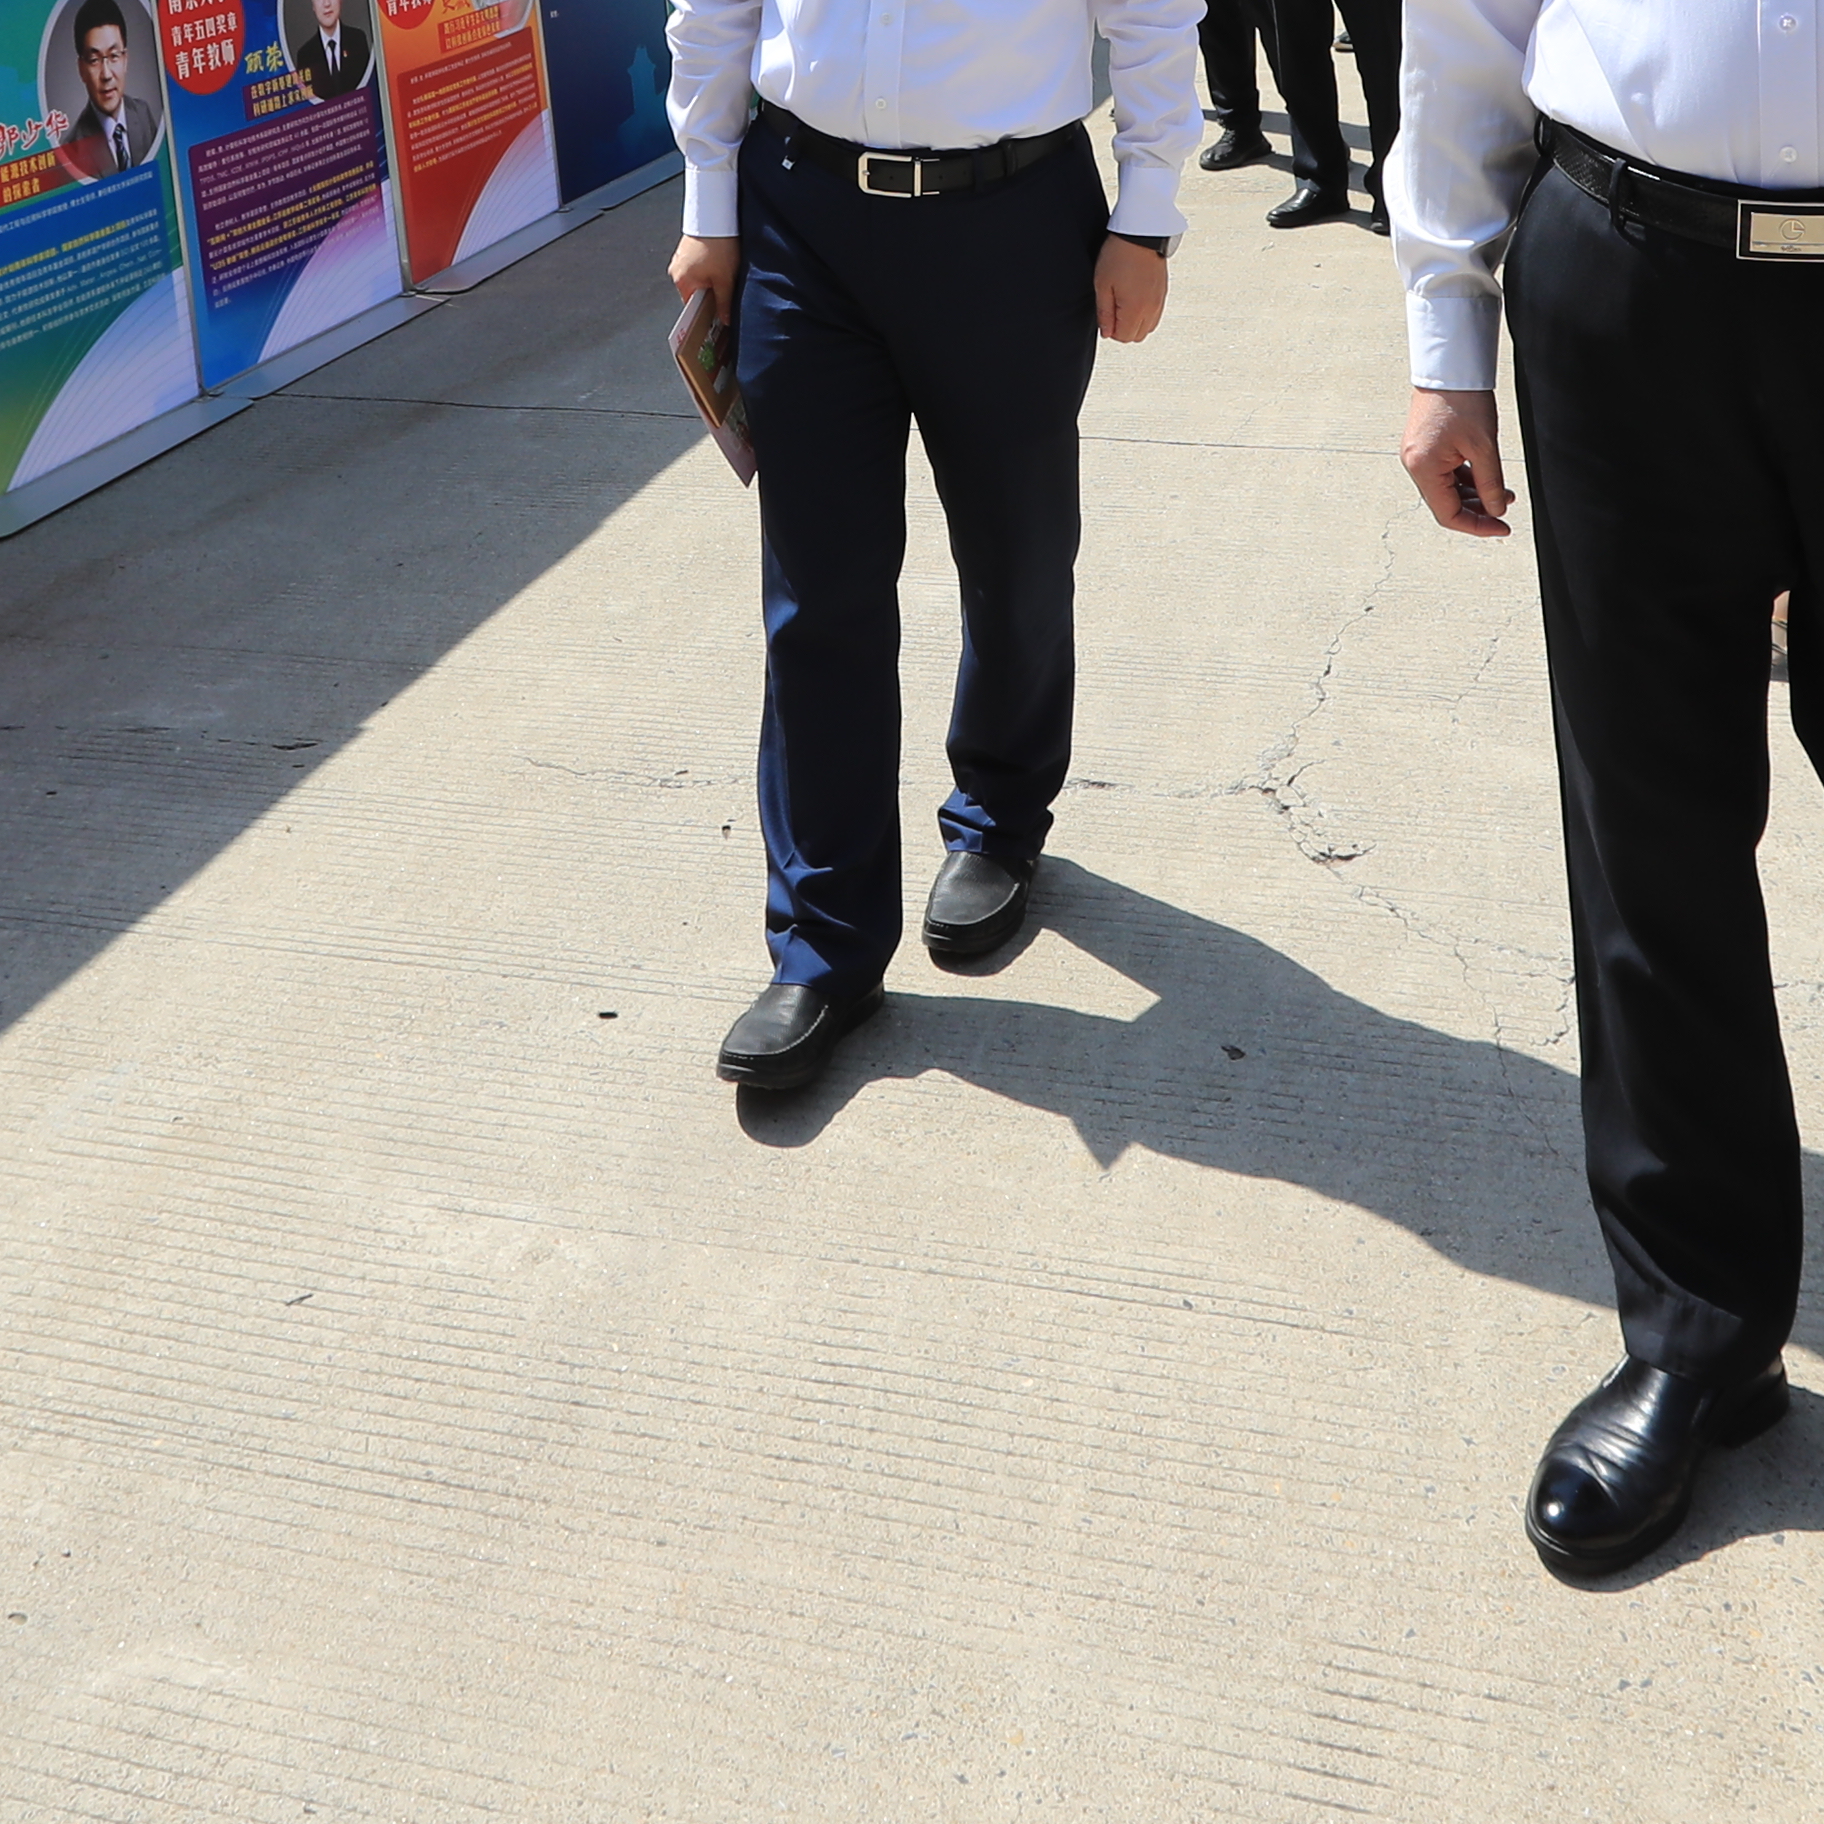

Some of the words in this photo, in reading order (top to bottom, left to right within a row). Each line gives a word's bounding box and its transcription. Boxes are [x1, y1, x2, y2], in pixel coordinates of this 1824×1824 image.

[170, 9, 238, 49] 青年五四奖章
[174, 37, 236, 81] 青年教师
